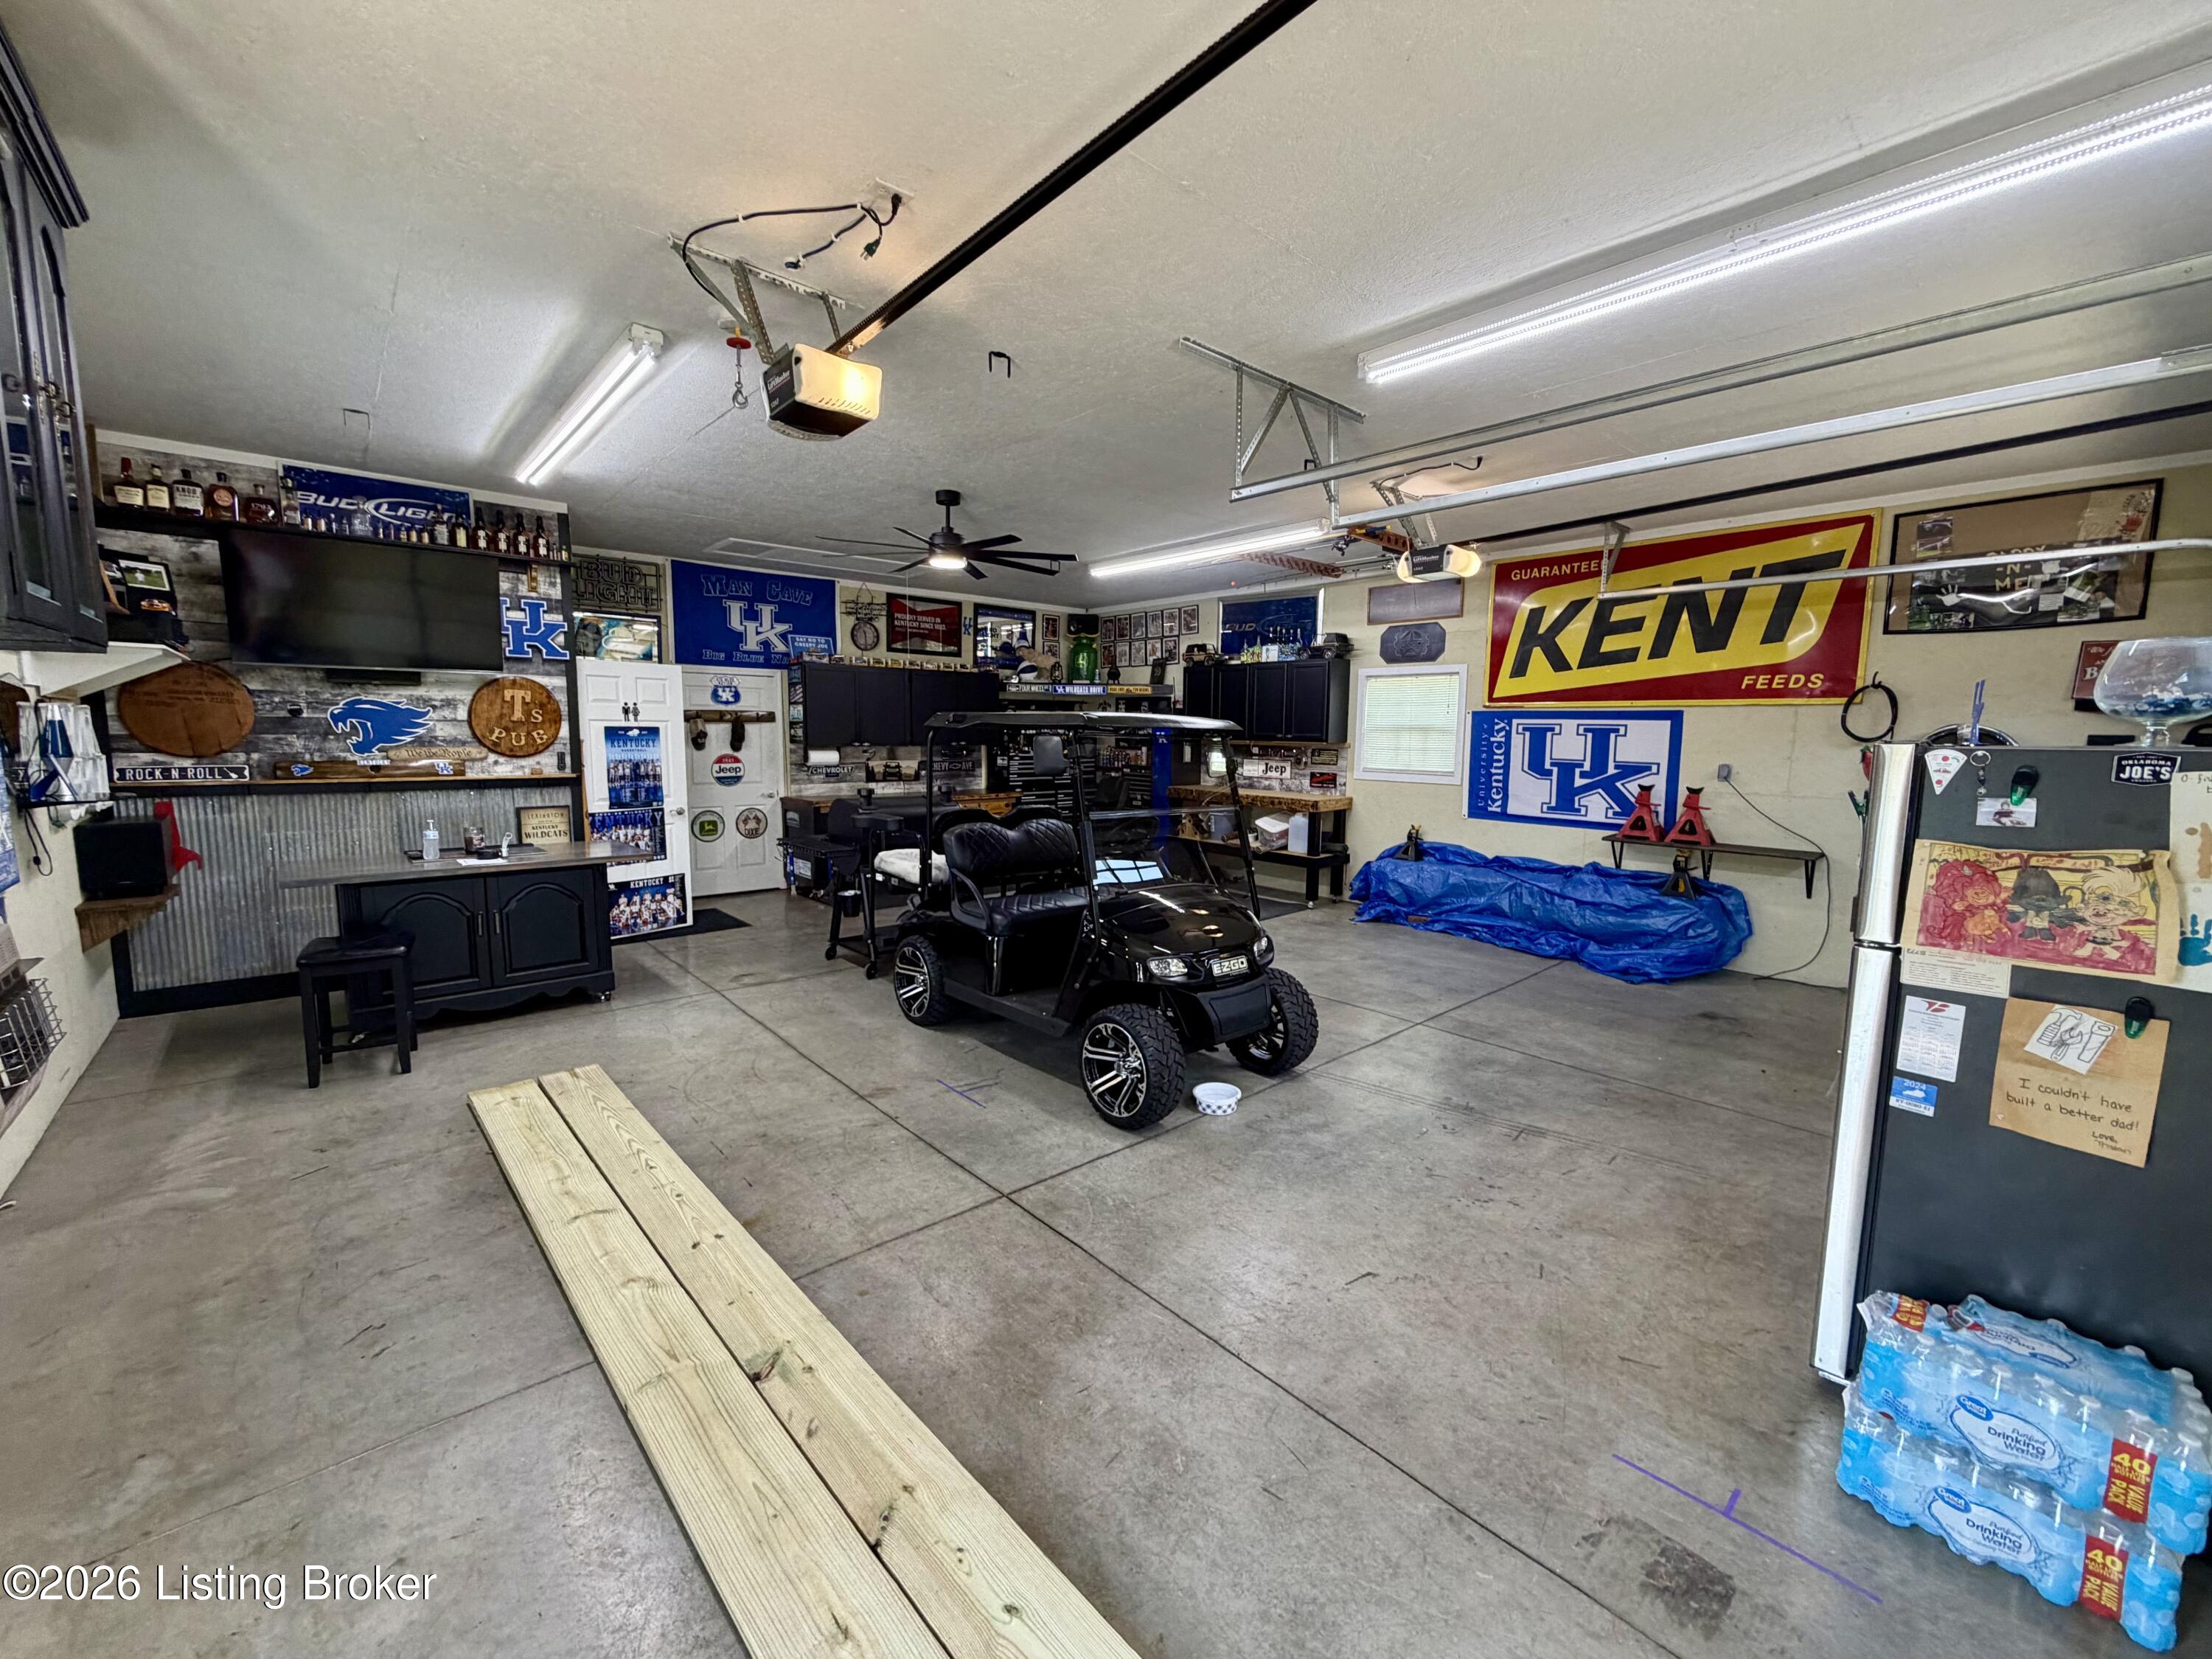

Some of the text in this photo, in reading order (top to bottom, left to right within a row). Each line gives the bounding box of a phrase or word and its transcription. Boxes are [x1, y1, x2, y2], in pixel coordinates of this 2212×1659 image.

[1508, 549, 1847, 679] KENT
[723, 598, 793, 653] UK
[1741, 672, 1826, 692] FEEDS
[489, 726, 549, 746] PUB
[611, 738, 657, 748] KENTUCKY
[714, 765, 742, 775] Jeep
[931, 762, 949, 771] HEVY
[1262, 762, 1287, 776] Jeep
[1478, 732, 1489, 807] University
[1487, 717, 1510, 813] Kentucky
[1516, 723, 1660, 821] UK
[2119, 765, 2172, 780] JOE'S
[2121, 759, 2171, 767] OKLAHOMA
[125, 768, 222, 781] ROCK-N-ROLL
[524, 830, 568, 839] WILDCATS
[630, 877, 664, 889] KENTUCKY
[2019, 1077, 2132, 1113] I couldn't have
[2006, 1091, 2140, 1132] built a better dad!
[1987, 1426, 2046, 1456] Drinking
[2003, 1440, 2045, 1461] Water
[2113, 1453, 2152, 1475] 40
[1966, 1517, 2023, 1550] Drinking
[1981, 1532, 2022, 1555] Water
[2087, 1548, 2123, 1572] 40
